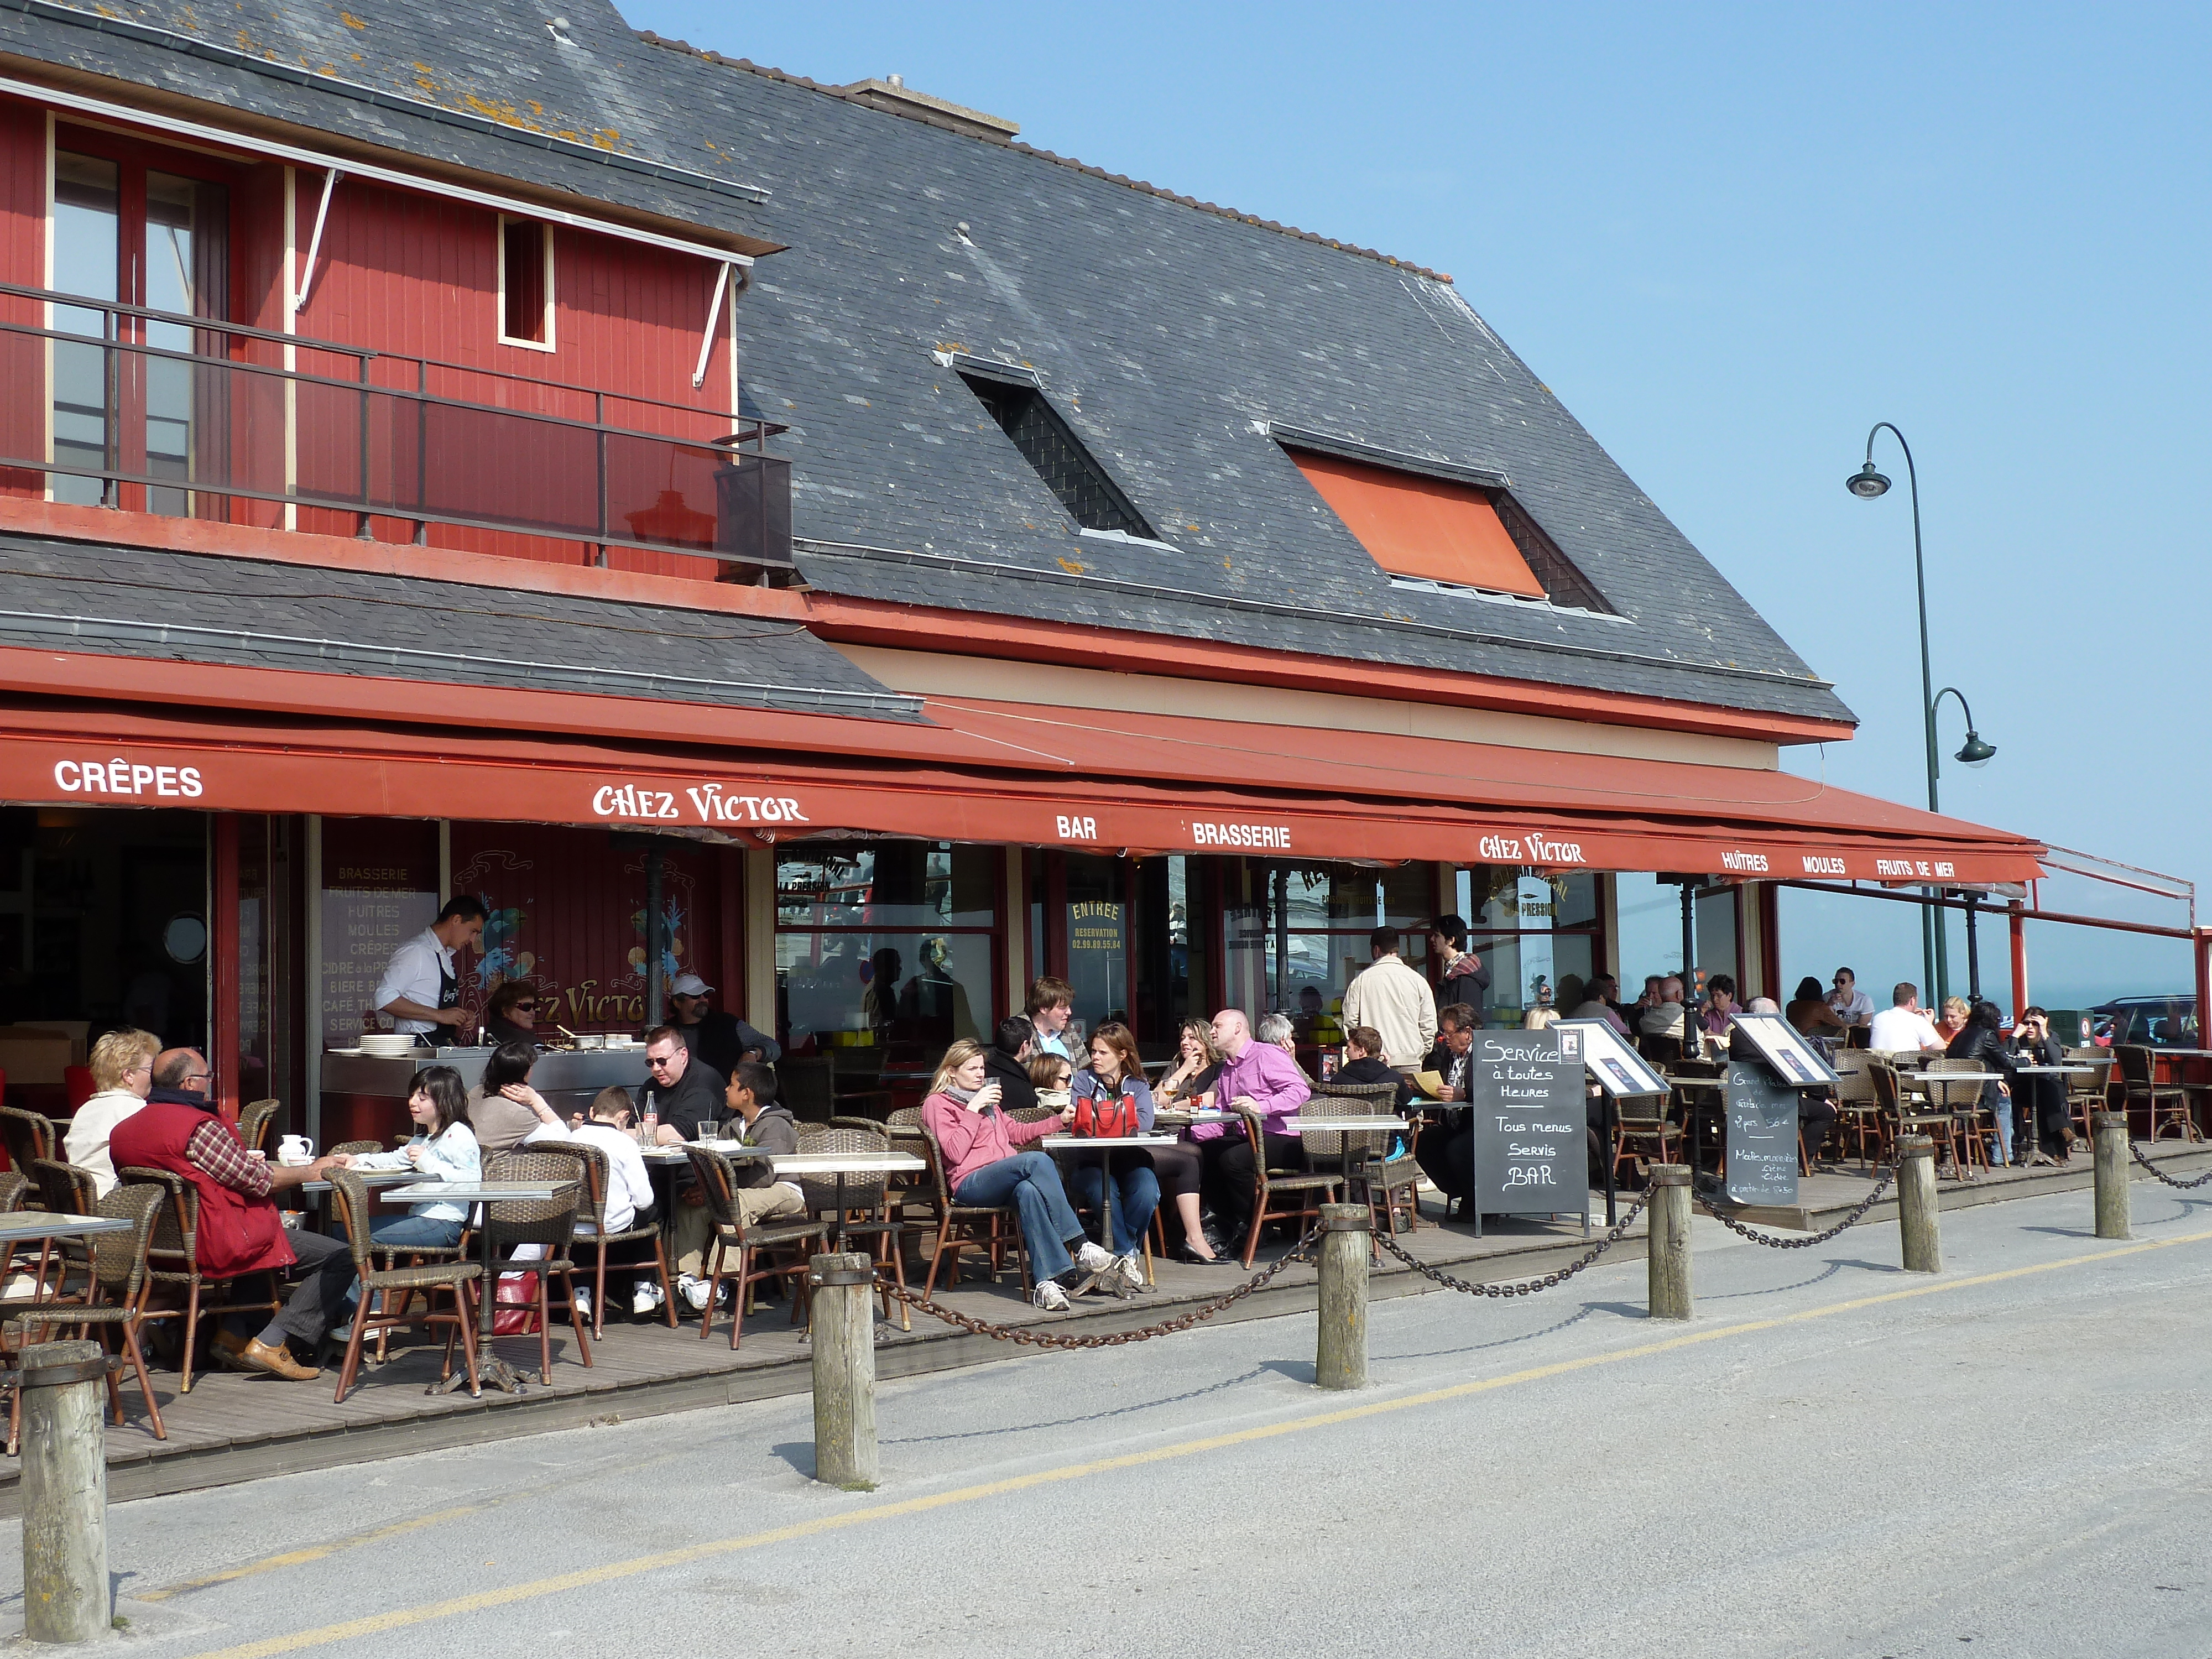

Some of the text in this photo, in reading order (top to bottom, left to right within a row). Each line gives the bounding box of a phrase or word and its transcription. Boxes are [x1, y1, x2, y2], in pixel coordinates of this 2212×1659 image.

[54, 757, 203, 797] CRÊPES
[592, 783, 810, 822] CHEZ VICTOR
[1056, 815, 1097, 840] BAR
[1192, 822, 1291, 848] BRASSERIE
[1479, 832, 1587, 863] CHEZ VICTOR
[1721, 849, 1768, 872] HUÎTRES
[1802, 855, 1846, 874] MOULES
[1876, 859, 1955, 878] FRUITS DE MER
[339, 867, 408, 880] BRASSERIE
[328, 885, 416, 900] FRUITS DE MER
[1072, 900, 1119, 921] ENTREE
[1521, 902, 1558, 916] PRESSION
[348, 924, 399, 936] MOULES
[1074, 927, 1118, 937] RESERVATION
[322, 961, 353, 975] CIDRE
[330, 980, 363, 993] BIERE
[565, 979, 646, 1028] VICTO
[330, 1018, 375, 1031] SERVICE
[1493, 1065, 1553, 1080] à toutes
[1495, 1116, 1573, 1133] Tous menus
[1502, 1165, 1557, 1192] BAR
